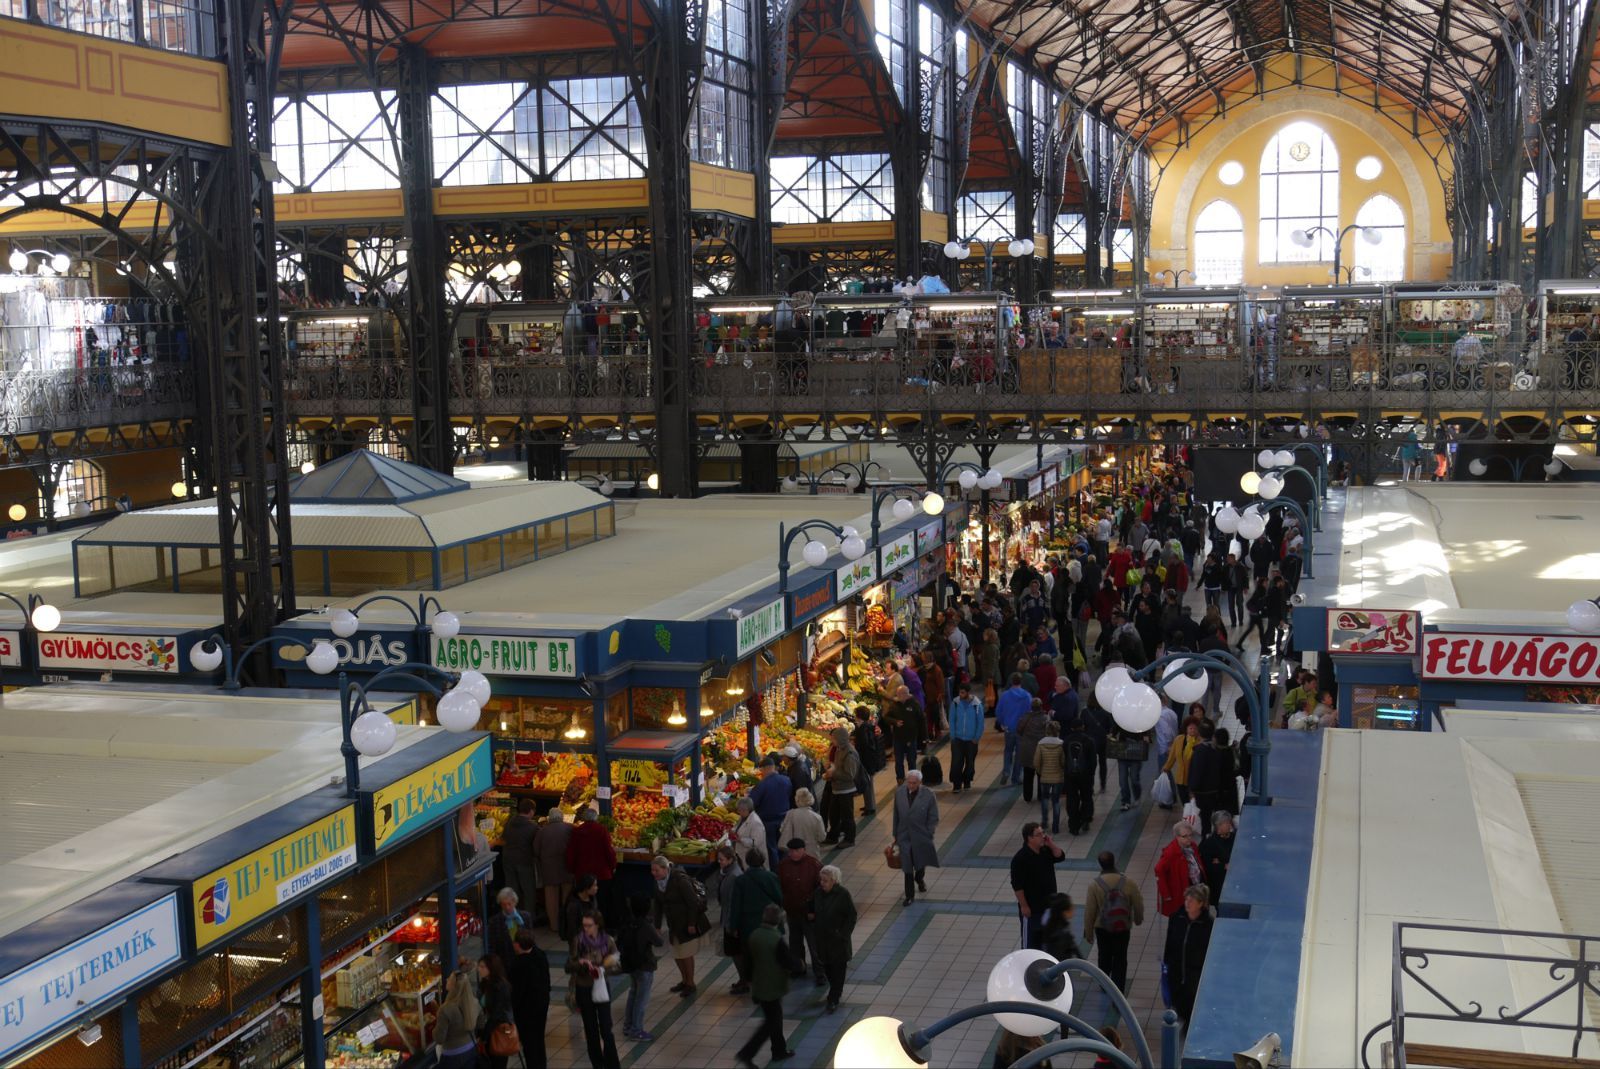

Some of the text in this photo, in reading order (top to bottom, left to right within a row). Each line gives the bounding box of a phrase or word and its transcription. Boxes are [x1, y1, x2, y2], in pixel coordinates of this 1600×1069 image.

[740, 607, 772, 651] AGRO-FRUIT
[41, 636, 143, 661] GYÜMÖLCS
[312, 635, 407, 666] OJÁS
[436, 638, 572, 673] AGRO-FRUIT BT.
[1426, 637, 1600, 679] FELVÁGO
[393, 759, 476, 826] PÉKÁRUK
[328, 855, 343, 873] 2005
[0, 928, 157, 1027] EJ TEJTERMÉK
